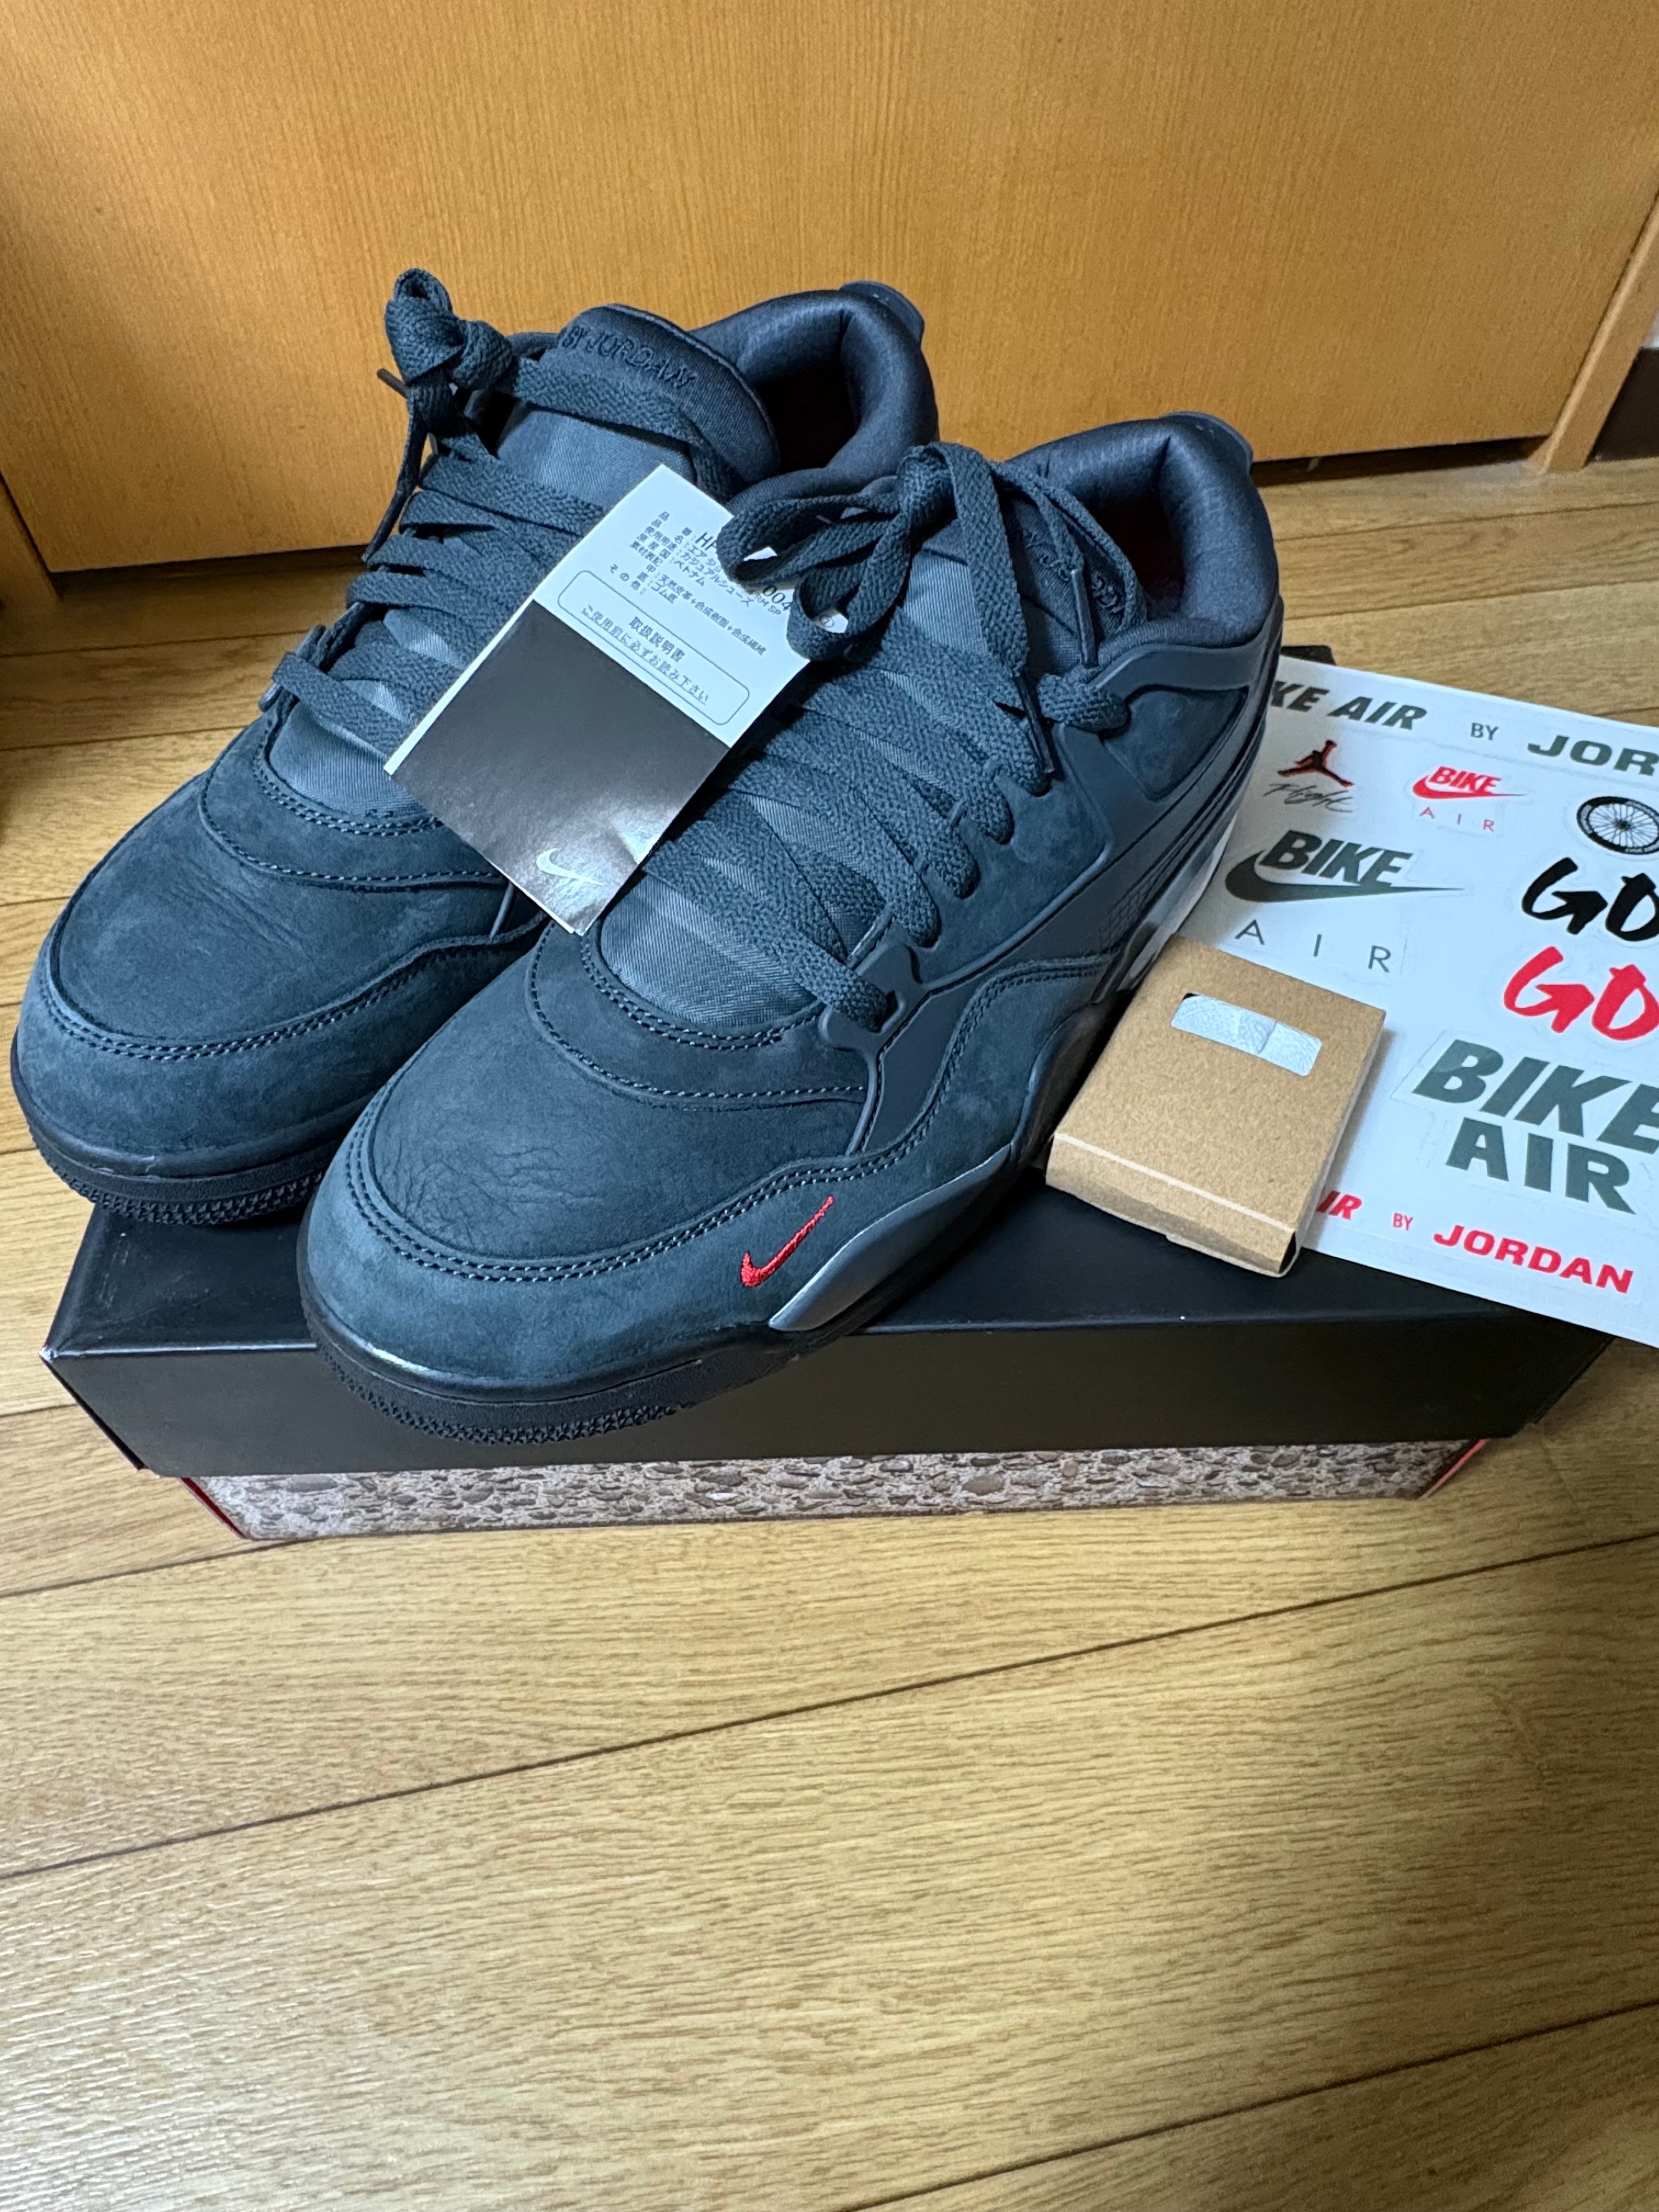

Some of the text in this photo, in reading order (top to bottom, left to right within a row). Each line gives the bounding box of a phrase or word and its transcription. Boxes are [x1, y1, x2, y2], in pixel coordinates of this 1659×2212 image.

[581, 605, 708, 701] ご使用前に必ずお読み下さい
[629, 616, 685, 662] 取扱説明書
[1271, 681, 1659, 777] KE AIR BY JOR
[1419, 806, 1494, 832] AIR
[1427, 766, 1502, 794] BIKE
[1259, 830, 1413, 888] BIKE
[1235, 919, 1391, 973] AIR
[1503, 946, 1659, 1040] GO
[1411, 1039, 1659, 1154] BIKE
[1445, 1117, 1637, 1215] AIR
[1317, 1190, 1634, 1294] IR BY JORDAN
